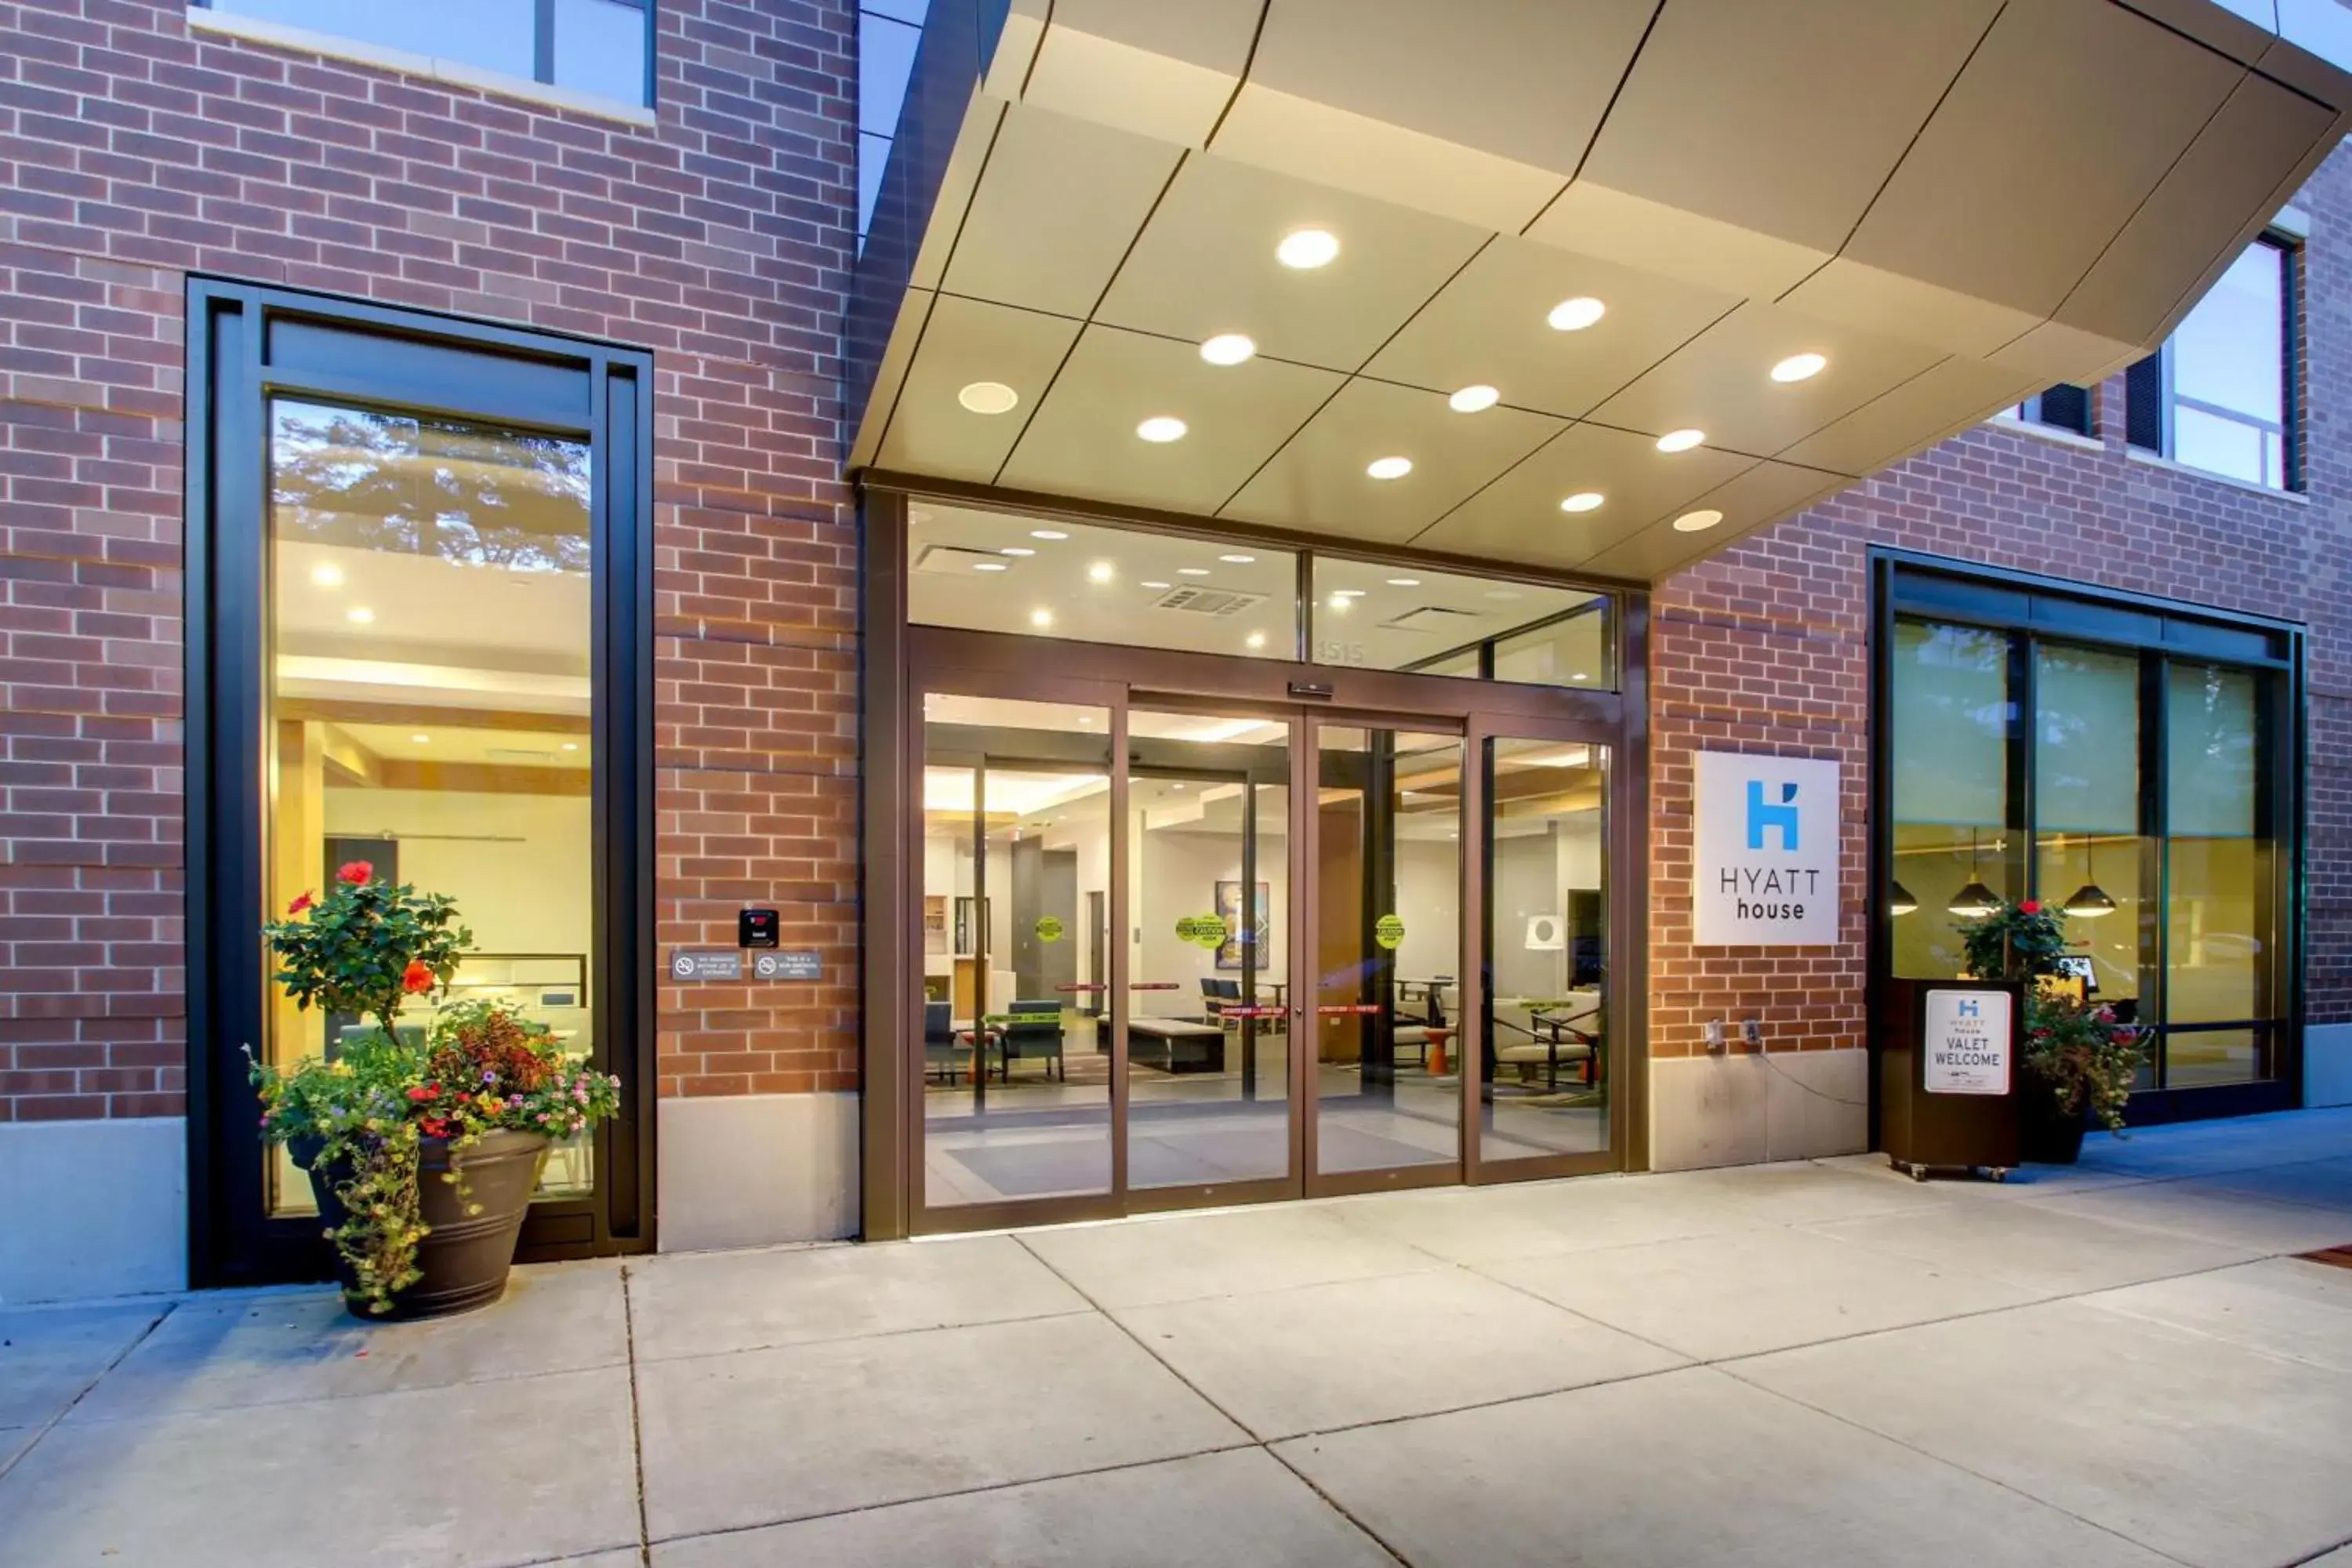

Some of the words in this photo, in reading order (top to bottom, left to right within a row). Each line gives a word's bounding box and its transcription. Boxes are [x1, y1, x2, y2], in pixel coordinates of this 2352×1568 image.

[1720, 867, 1820, 895] HYATT
[1737, 898, 1804, 920] house
[1946, 1037, 1989, 1051] VALET
[1935, 1053, 2001, 1066] WELCOME
